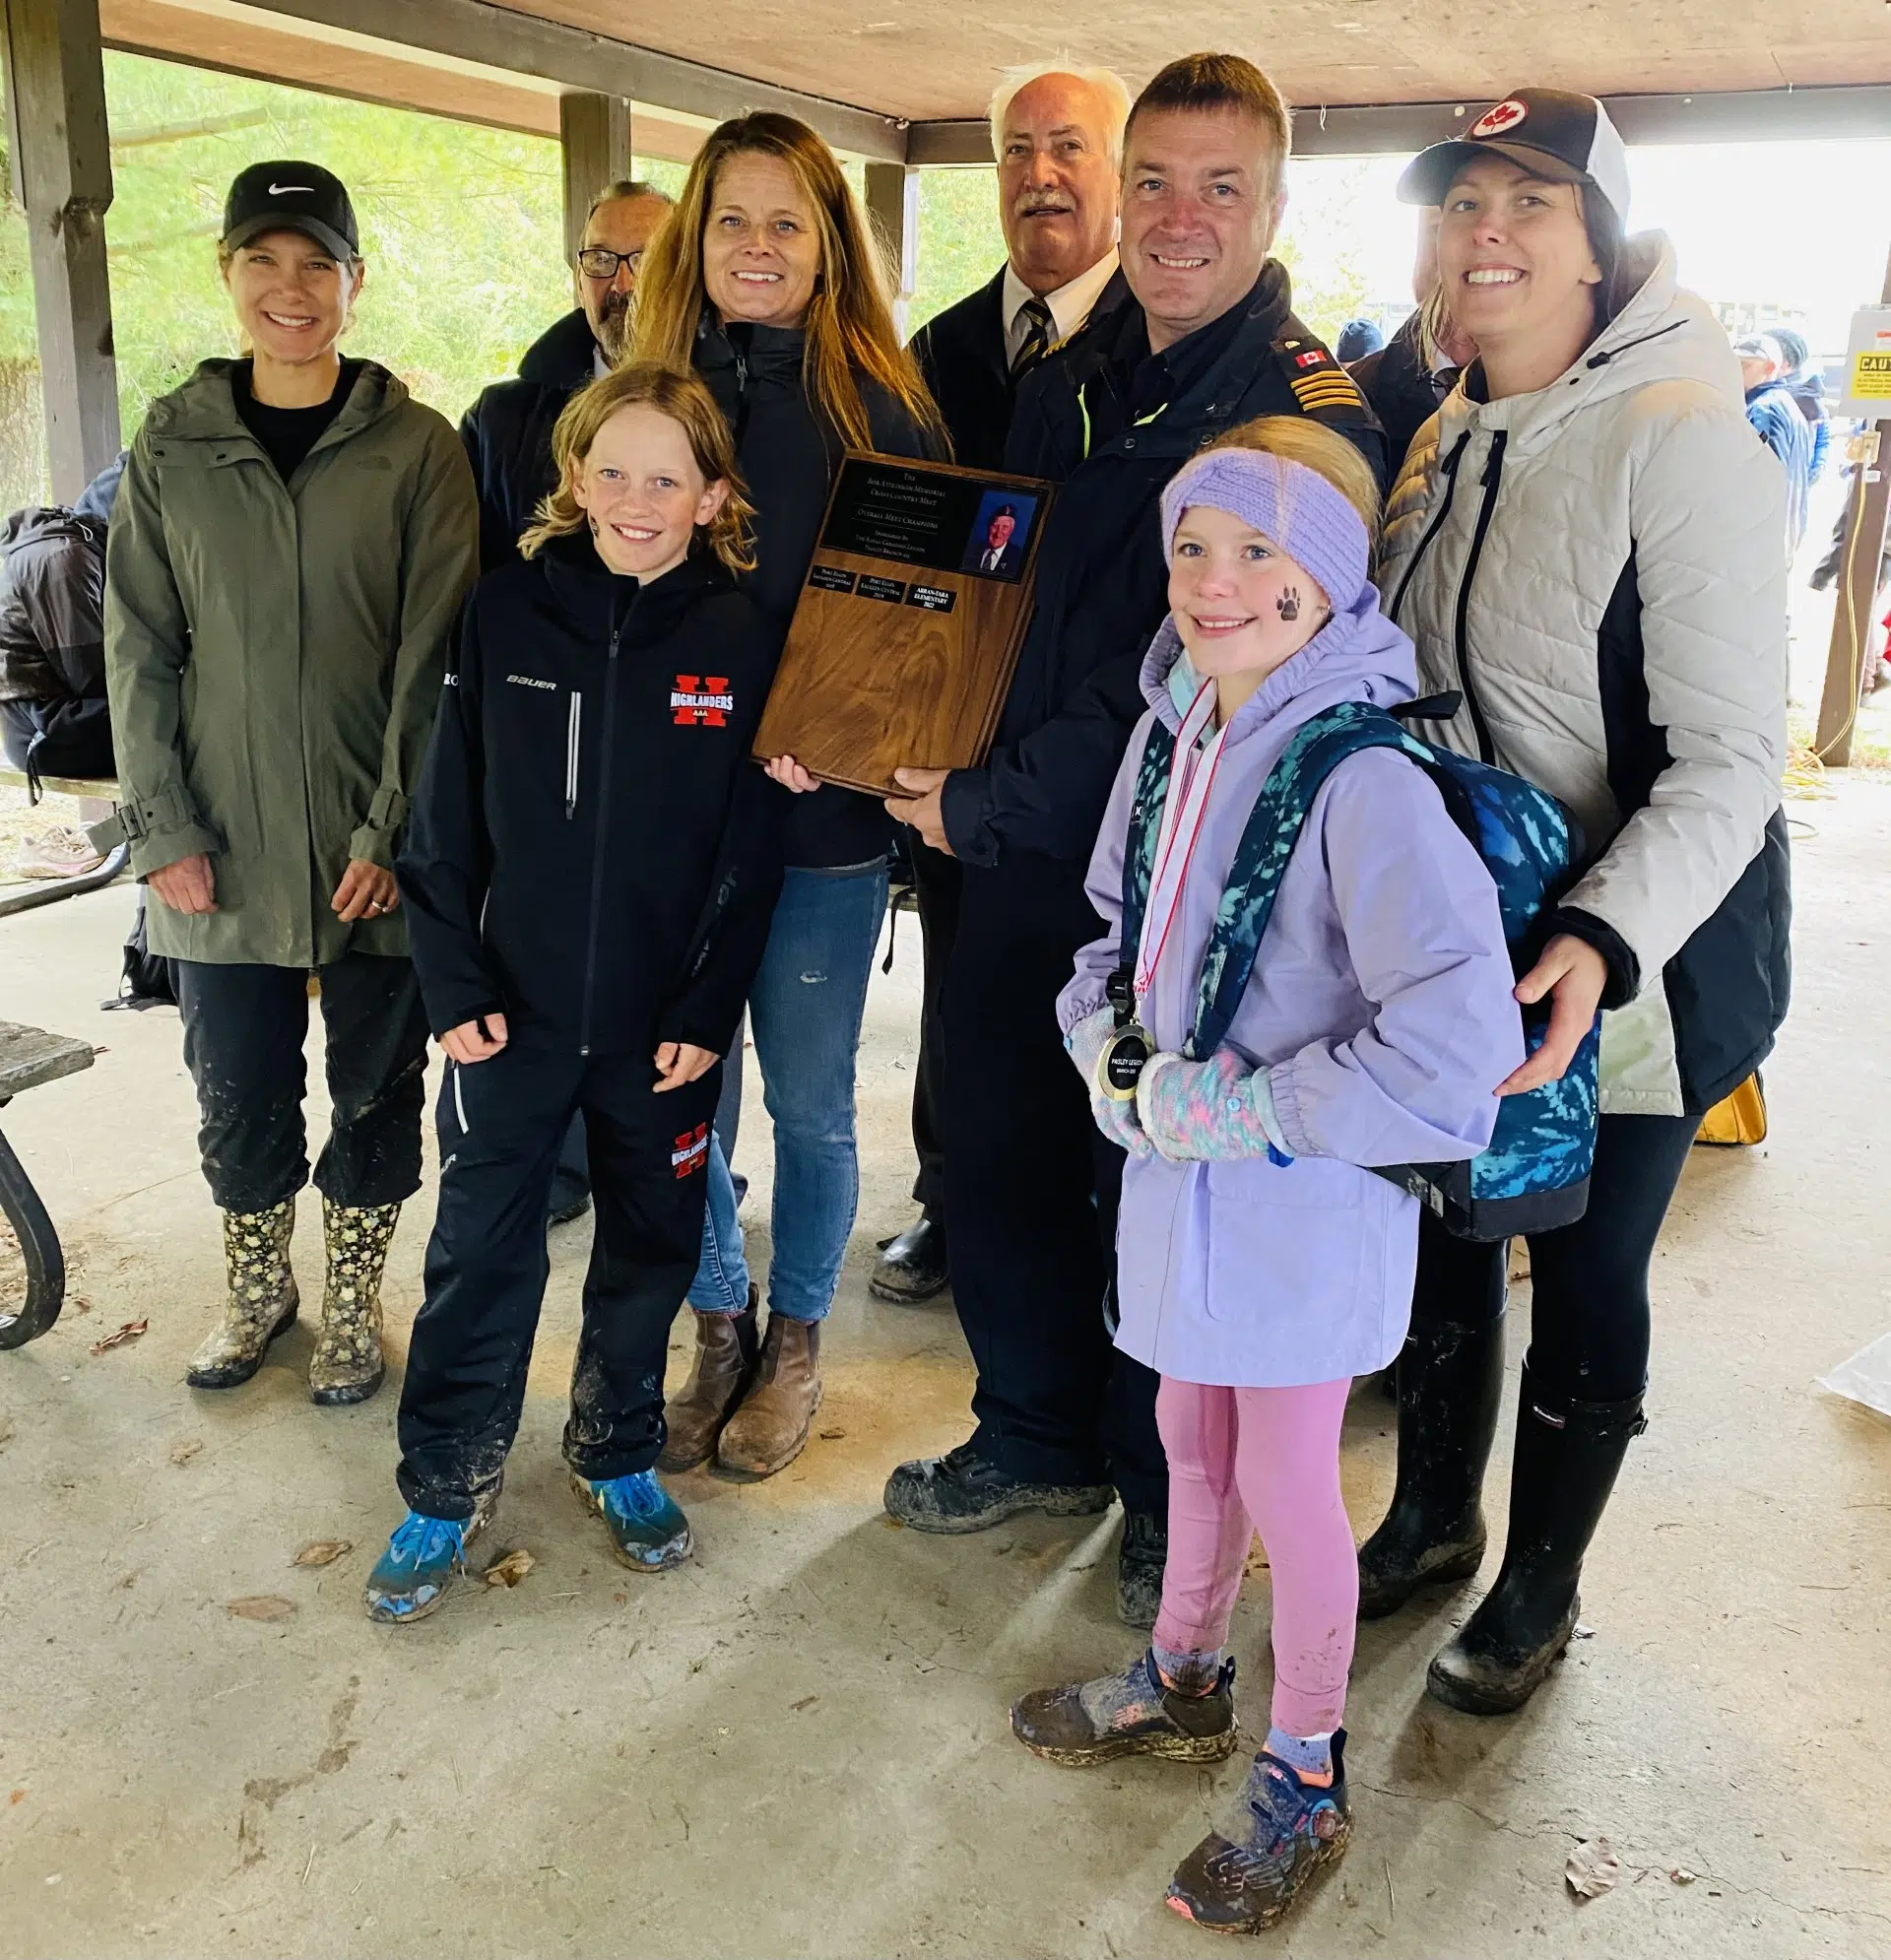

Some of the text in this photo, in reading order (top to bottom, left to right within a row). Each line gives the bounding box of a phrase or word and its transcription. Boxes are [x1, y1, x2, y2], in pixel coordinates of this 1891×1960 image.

[903, 473, 916, 482] THE
[871, 489, 939, 506] CROSS COUNTRY MEET
[914, 485, 946, 497] MEMORIAL
[857, 508, 939, 529] OVERALL MEET CHAMPIONS
[913, 593, 948, 605] ELEMENTARY
[916, 587, 949, 600] ARRAN-TARA
[506, 675, 557, 690] BAUER
[670, 691, 734, 711] HIGHLANDERS
